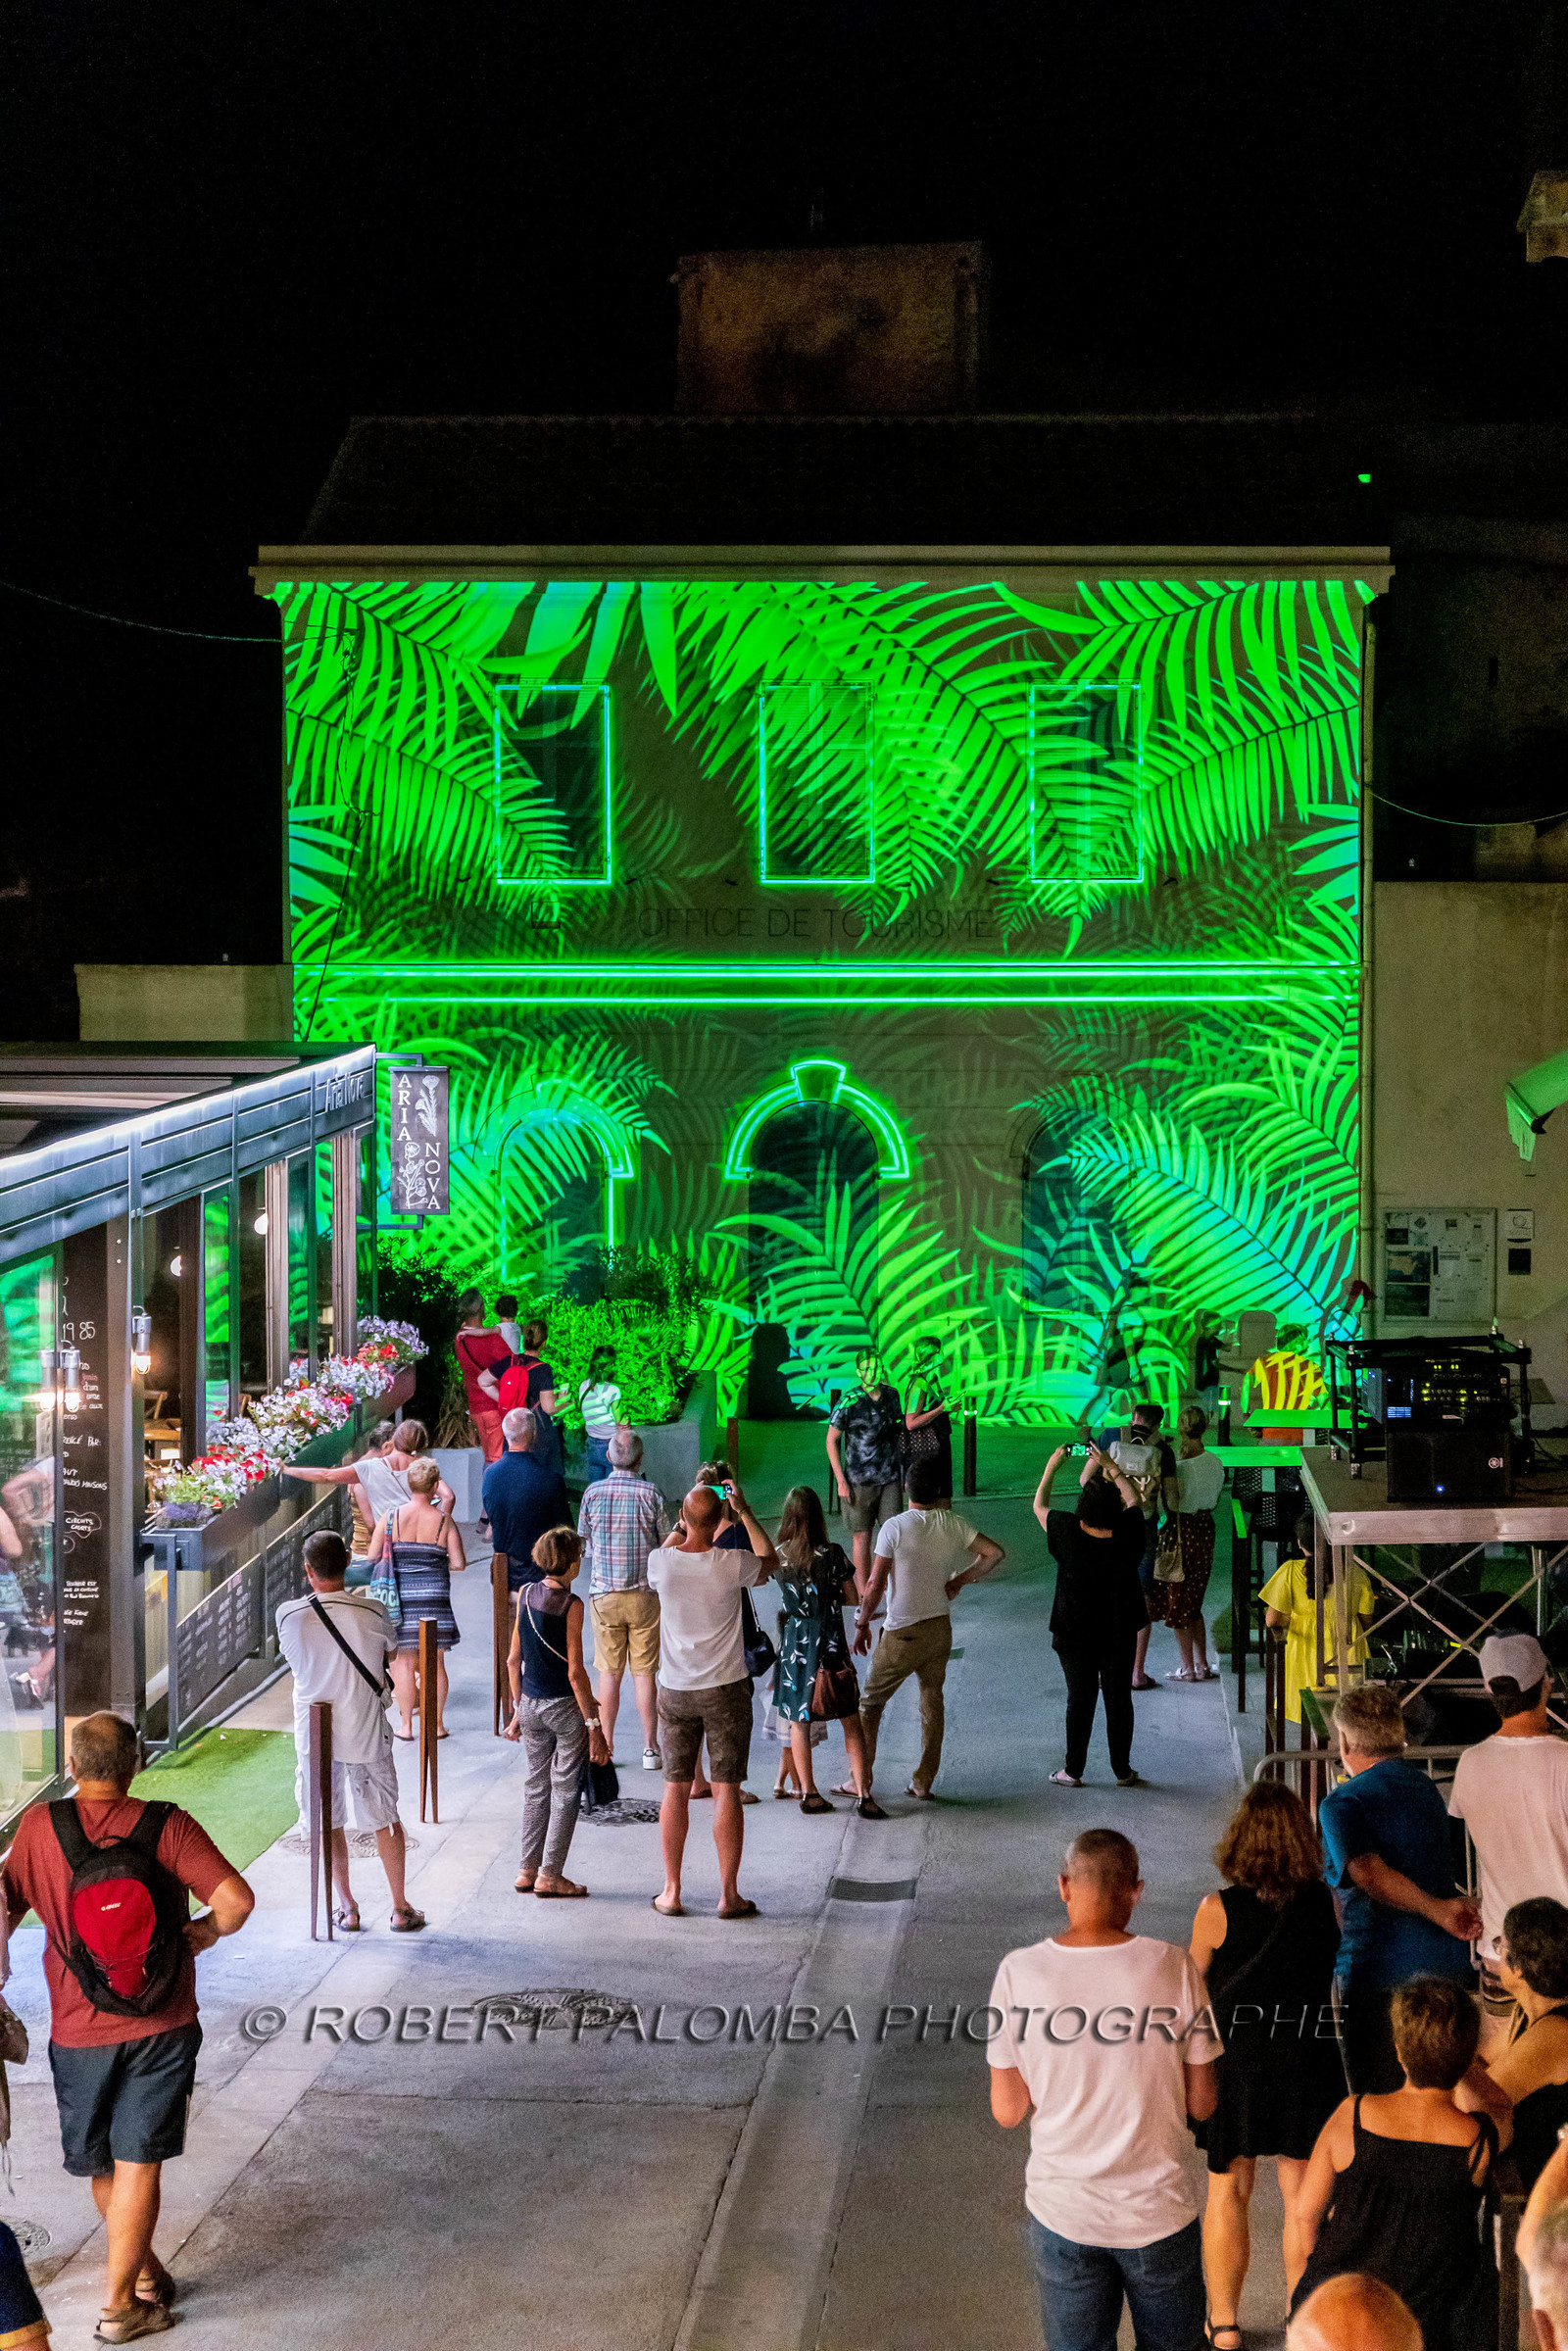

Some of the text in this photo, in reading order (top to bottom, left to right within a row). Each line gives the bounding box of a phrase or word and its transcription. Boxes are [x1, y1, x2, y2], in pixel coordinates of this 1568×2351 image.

[638, 907, 995, 938] OFFICE DE TOURISME
[397, 1073, 413, 1142] ARIA
[425, 1142, 441, 1210] NOVA
